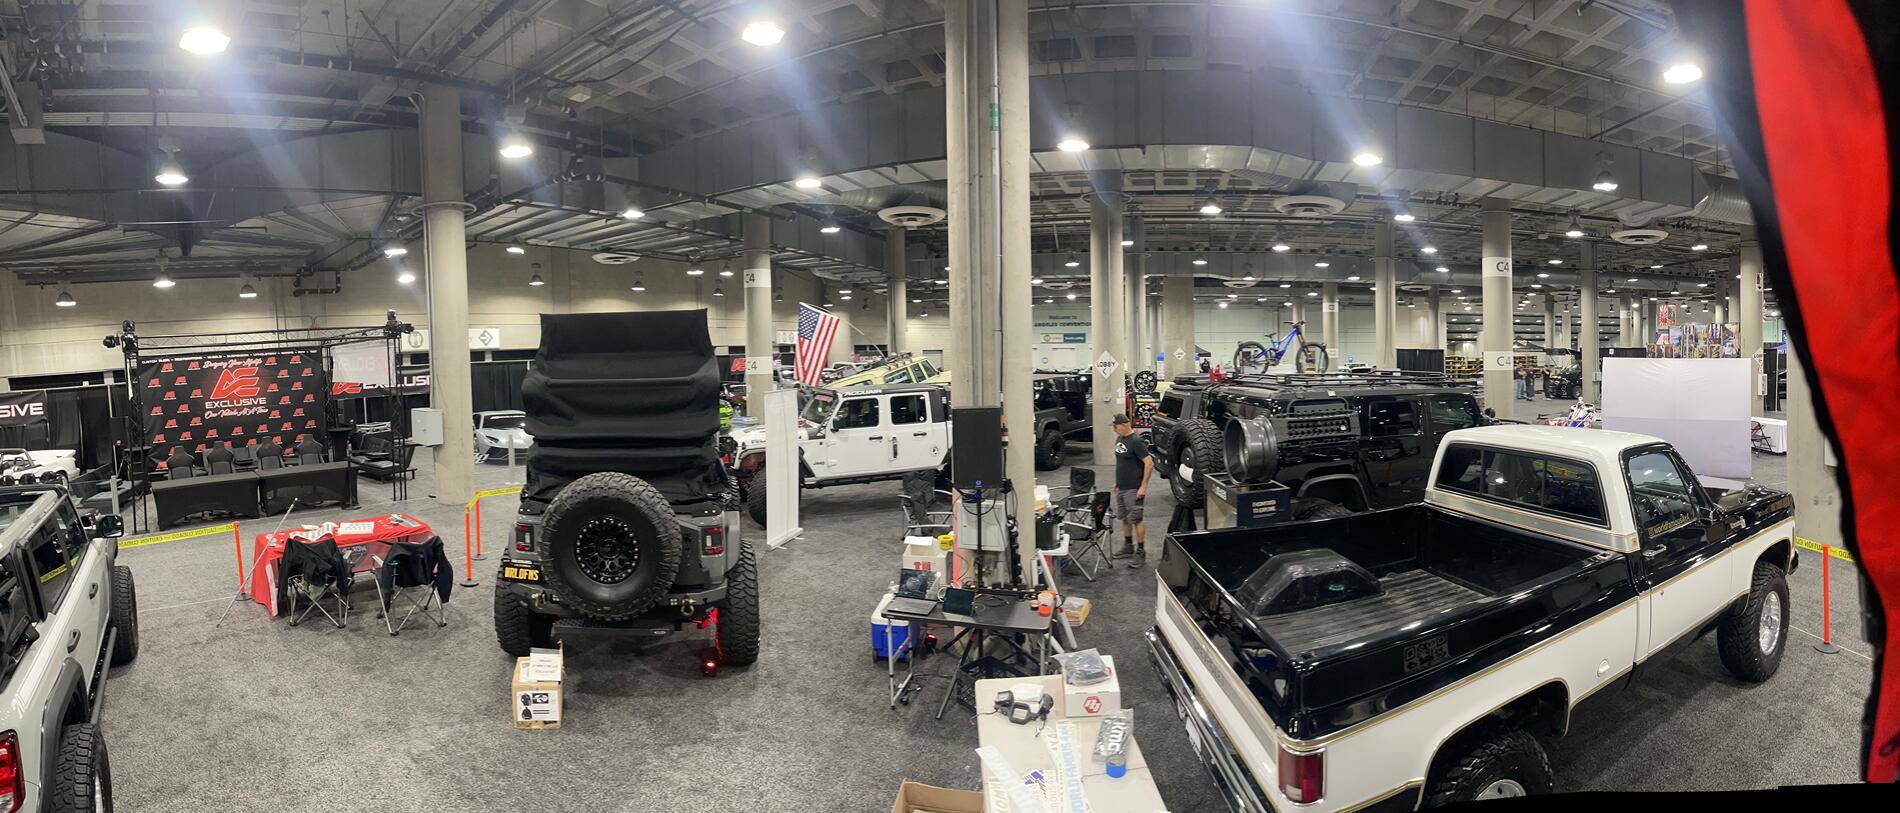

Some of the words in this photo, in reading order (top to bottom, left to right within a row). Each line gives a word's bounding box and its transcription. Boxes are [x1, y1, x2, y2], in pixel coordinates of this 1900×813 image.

[1496, 261, 1510, 272] C4
[1496, 356, 1511, 366] C4
[205, 397, 267, 409] EXCLUSIVE
